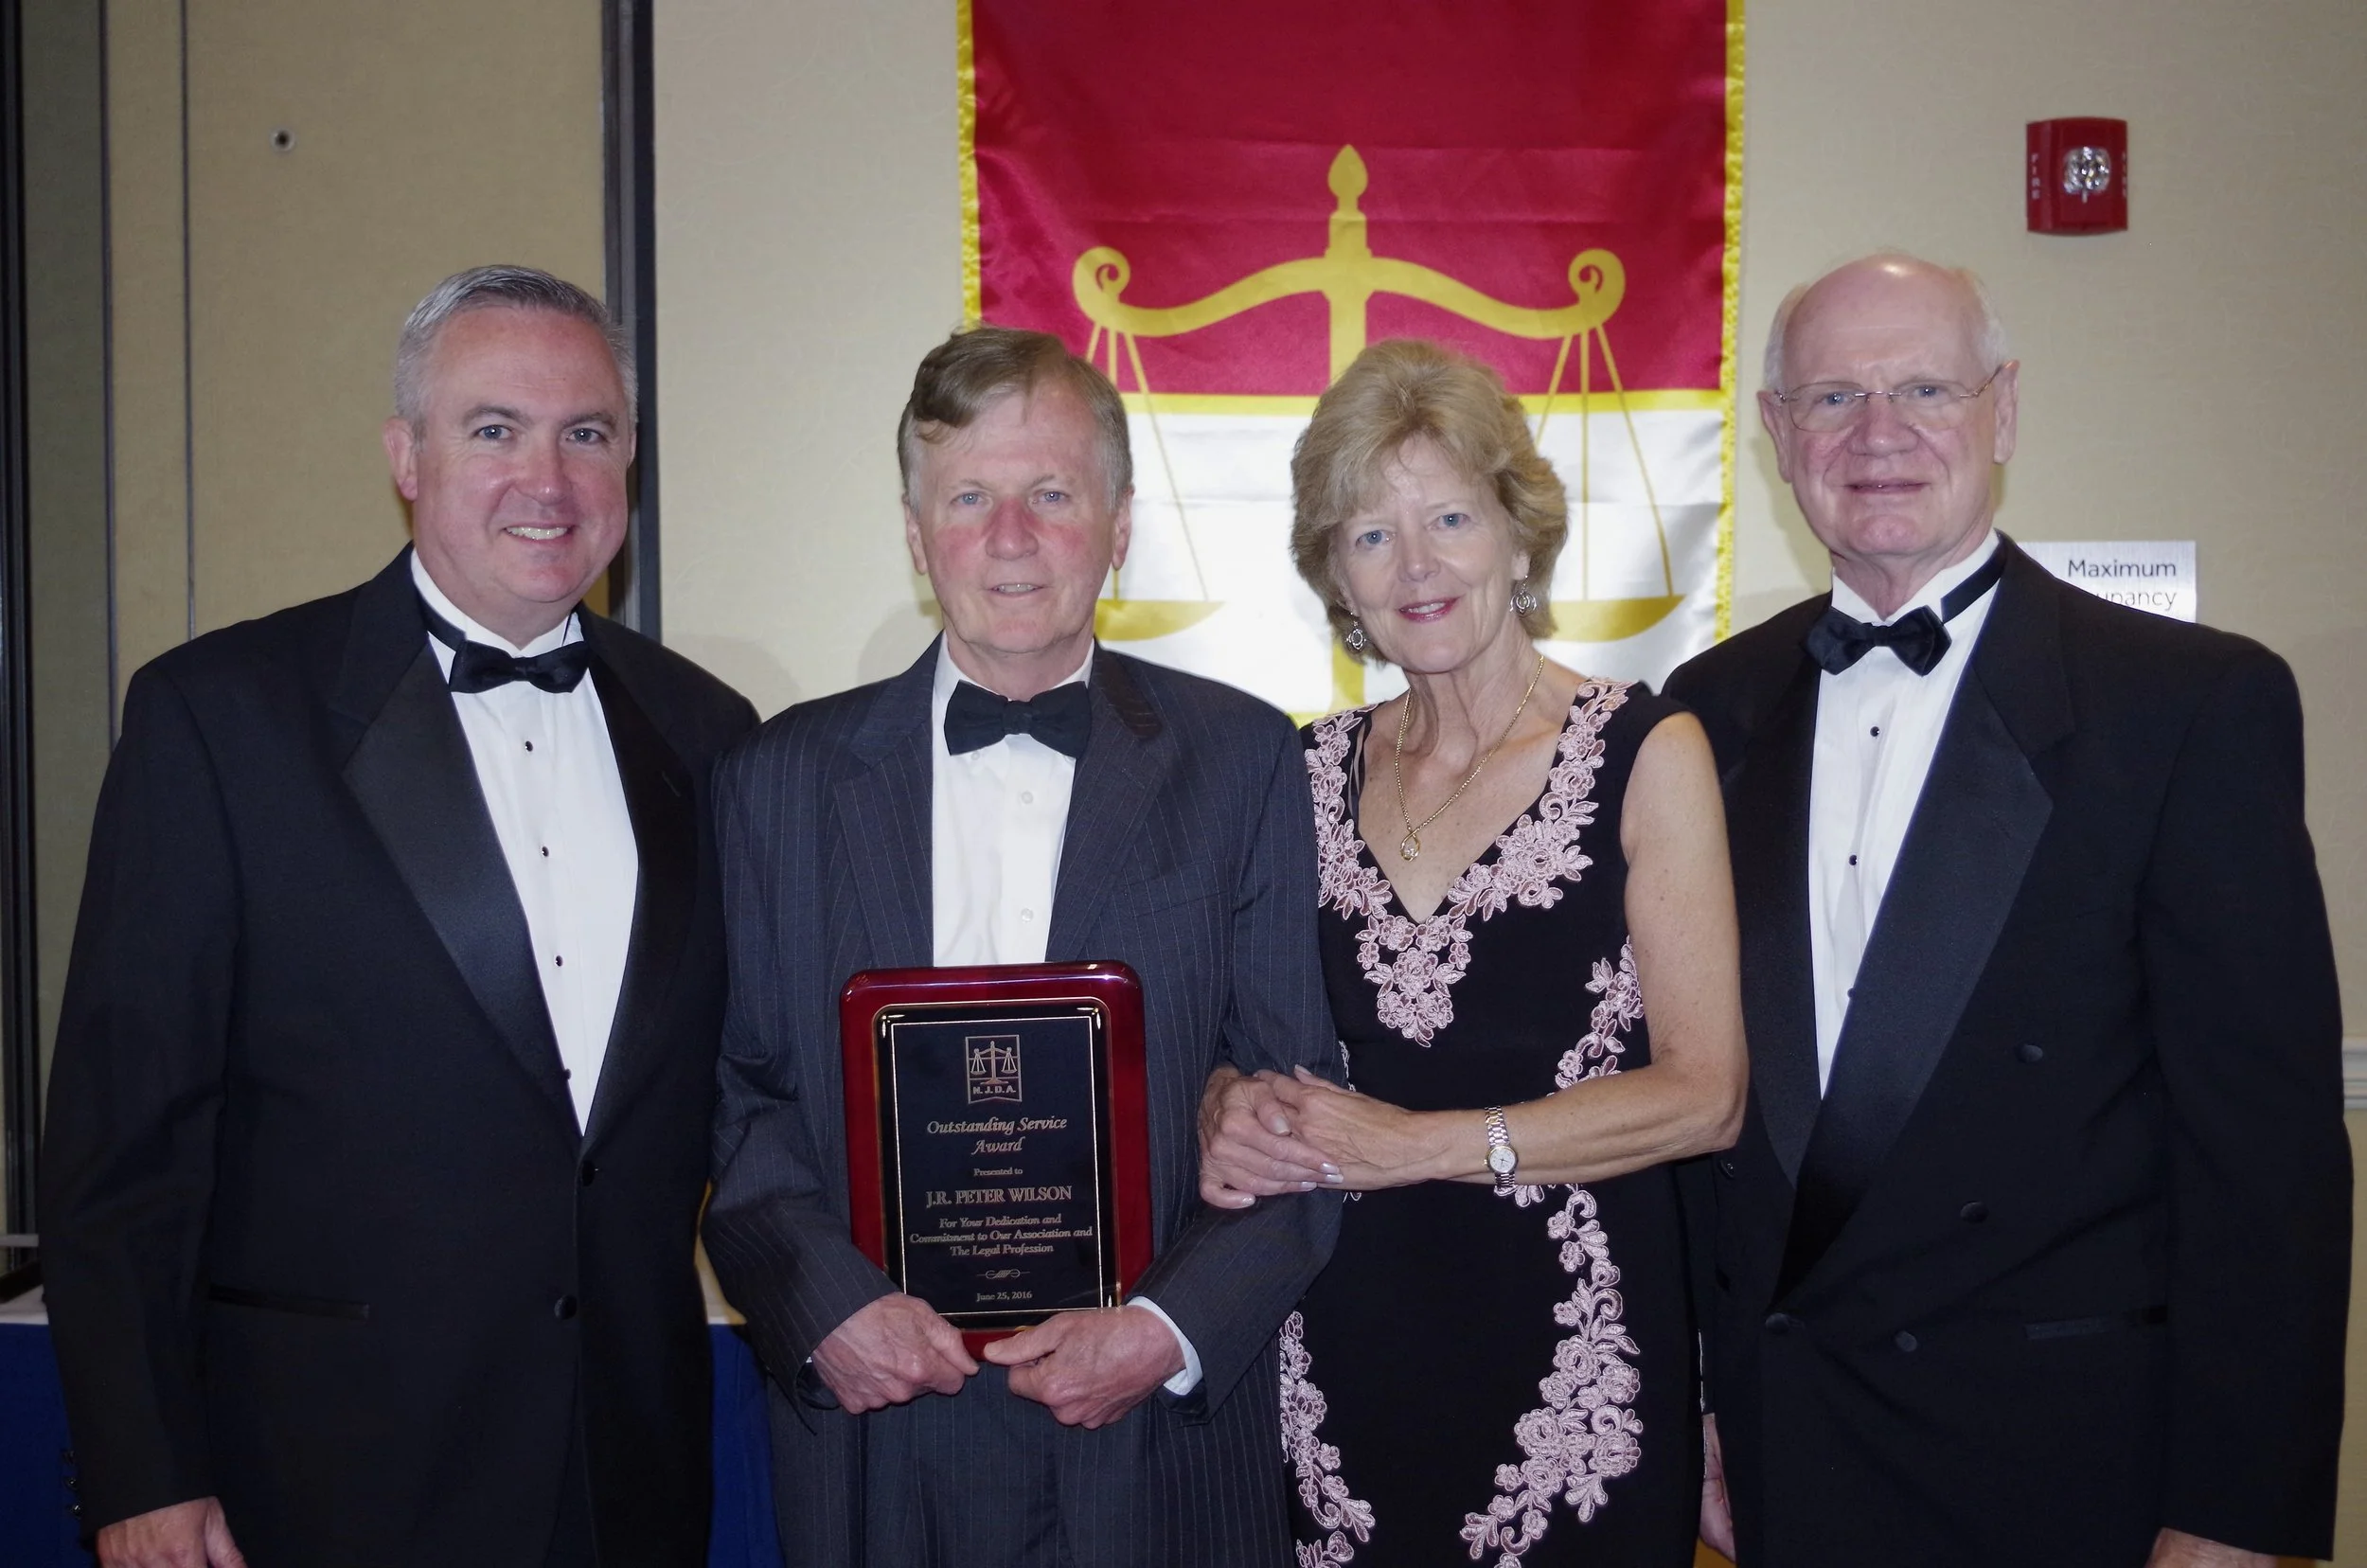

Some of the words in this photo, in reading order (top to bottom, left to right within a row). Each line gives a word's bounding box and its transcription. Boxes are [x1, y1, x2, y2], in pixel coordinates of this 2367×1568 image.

[2068, 559, 2177, 578] Maximum
[927, 1116, 1015, 1135] Outstanding
[1018, 1115, 1067, 1131] Service
[971, 1136, 1025, 1155] Award
[973, 1167, 1013, 1177] Presented
[926, 1190, 952, 1208] J.R.
[955, 1188, 1006, 1204] PETER
[1008, 1185, 1072, 1202] WILSON
[939, 1218, 957, 1228] For
[960, 1217, 983, 1228] Your
[986, 1216, 1040, 1226] Dedication
[1041, 1213, 1061, 1224] and
[910, 1233, 975, 1243] Commitment
[977, 1233, 988, 1241] to
[989, 1230, 1012, 1240] Our
[1014, 1228, 1071, 1239] Association
[1073, 1226, 1093, 1238] and
[950, 1245, 970, 1256] The
[971, 1245, 1001, 1257] Legal
[1003, 1243, 1054, 1256] Profession
[976, 1292, 994, 1302] June
[996, 1292, 1010, 1301] 25,
[1011, 1291, 1033, 1300] 2016
